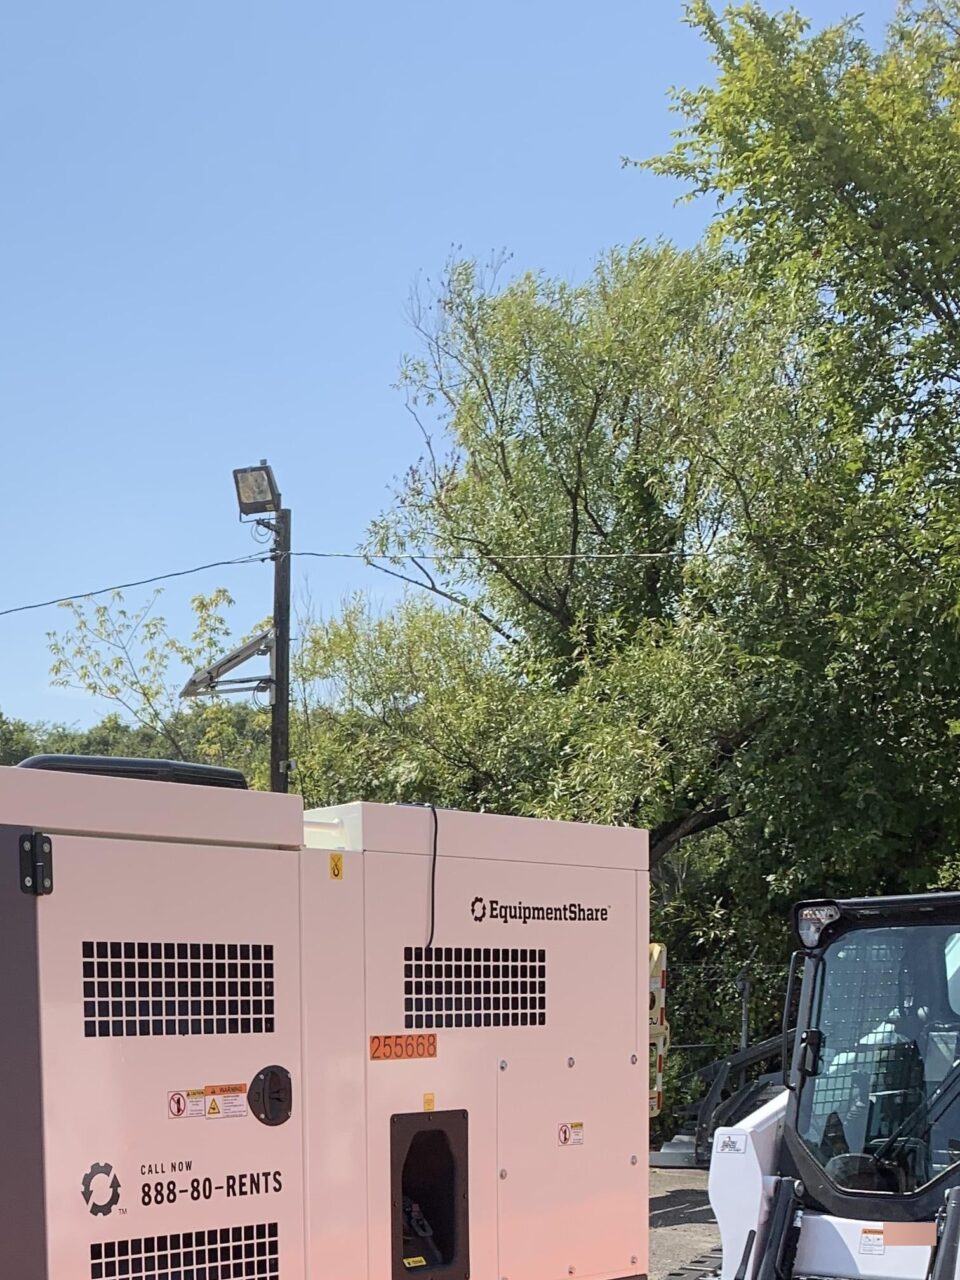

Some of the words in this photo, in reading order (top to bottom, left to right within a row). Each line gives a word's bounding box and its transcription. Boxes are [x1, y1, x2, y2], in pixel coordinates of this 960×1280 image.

[489, 900, 609, 924] EquipmentShare
[371, 1033, 437, 1059] 255668
[140, 1163, 166, 1175] CALL
[171, 1160, 193, 1173] NOW
[141, 1170, 283, 1206] 888-80-RENTS
